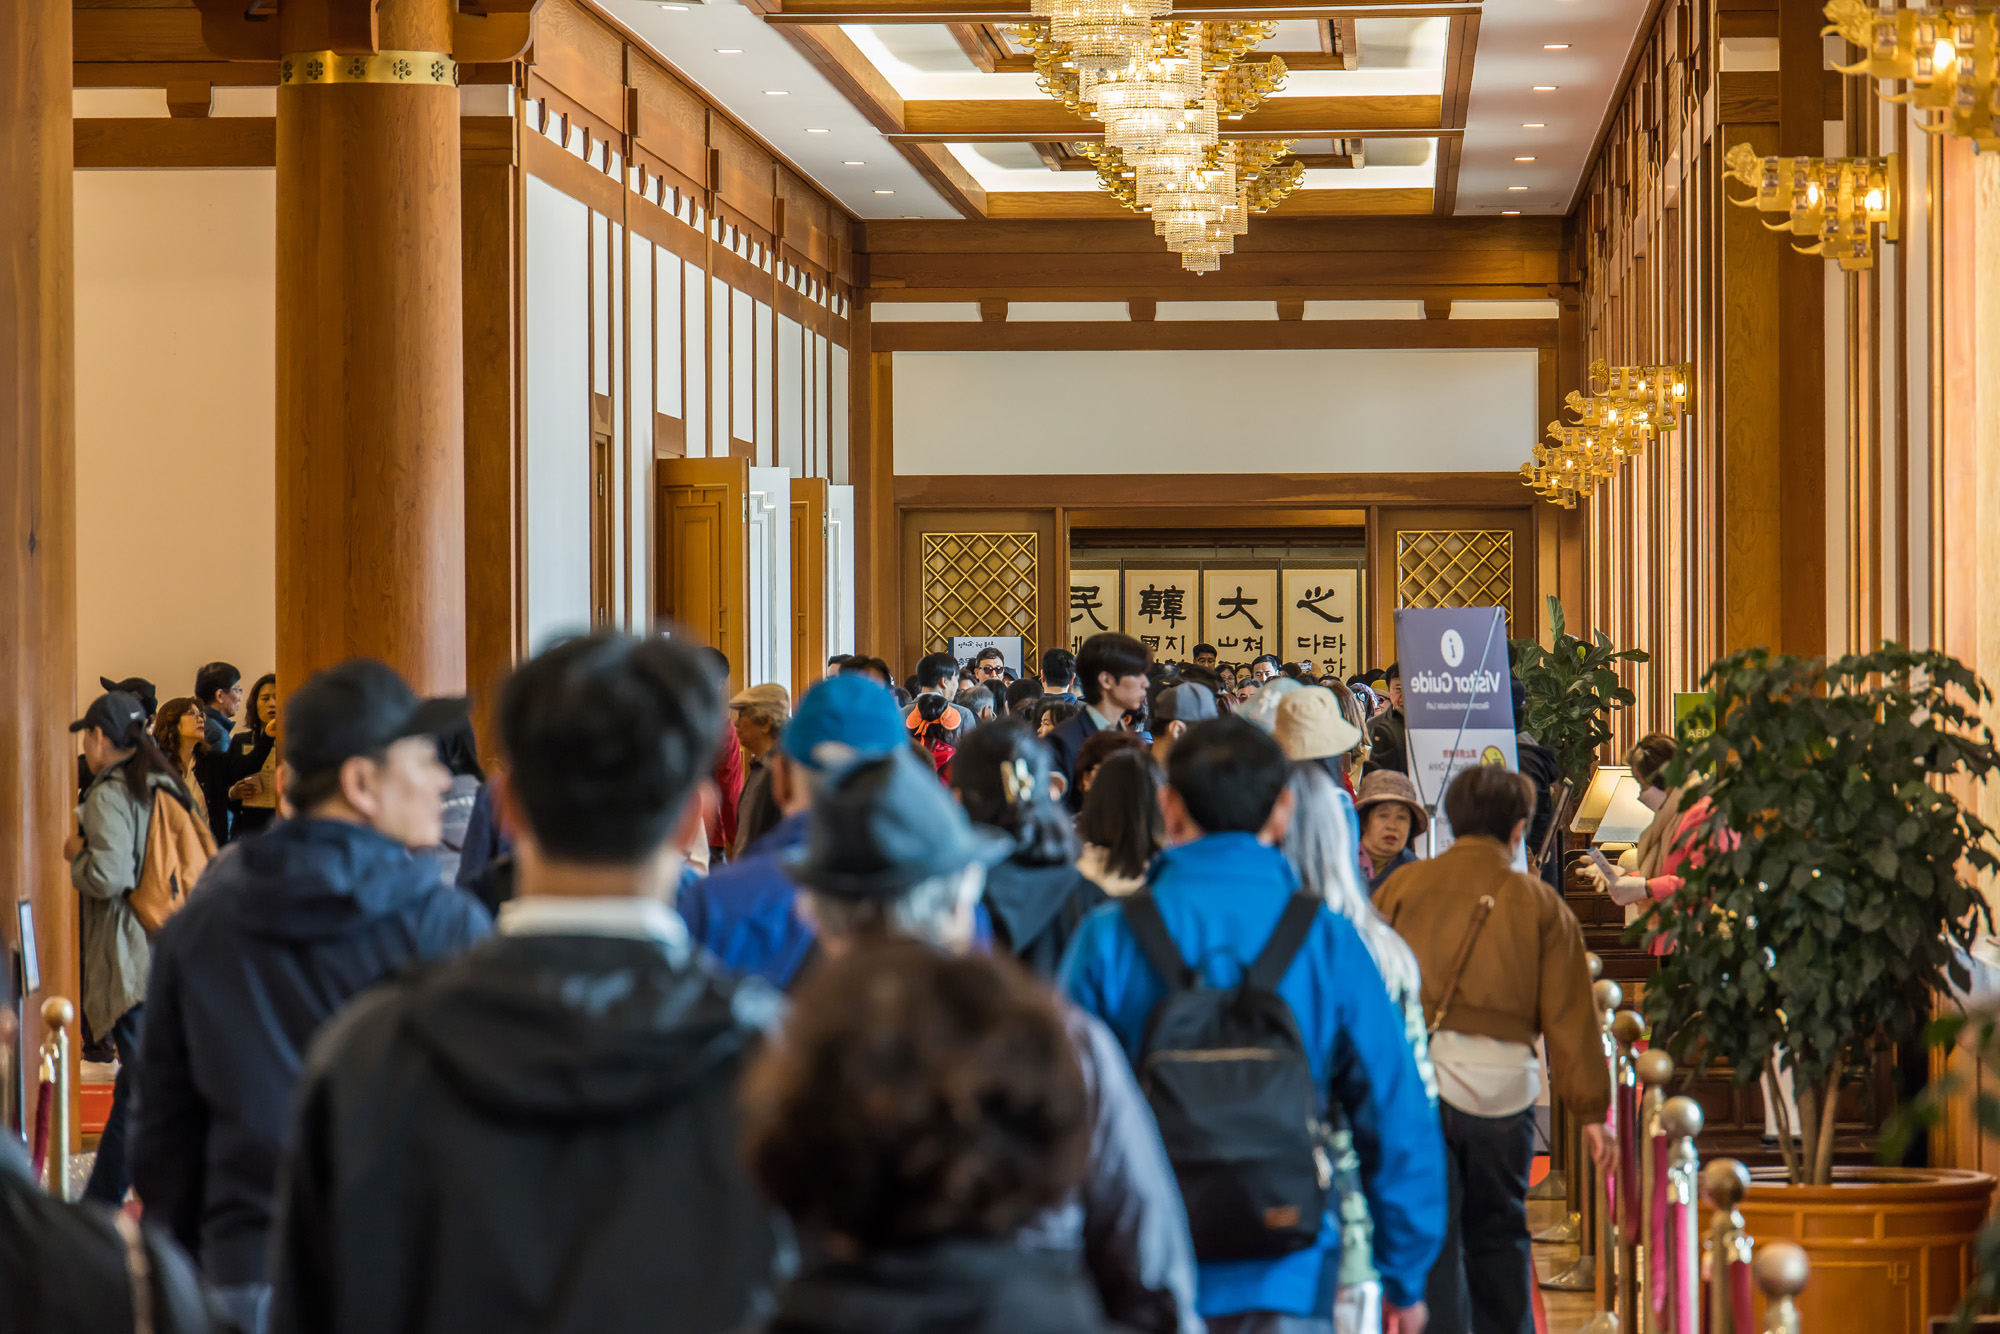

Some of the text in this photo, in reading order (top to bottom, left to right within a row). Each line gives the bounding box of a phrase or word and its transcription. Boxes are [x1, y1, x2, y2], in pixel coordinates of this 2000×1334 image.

[1138, 583, 1187, 629] 韓
[1216, 586, 1263, 629] 大
[1688, 728, 1710, 738] AED
